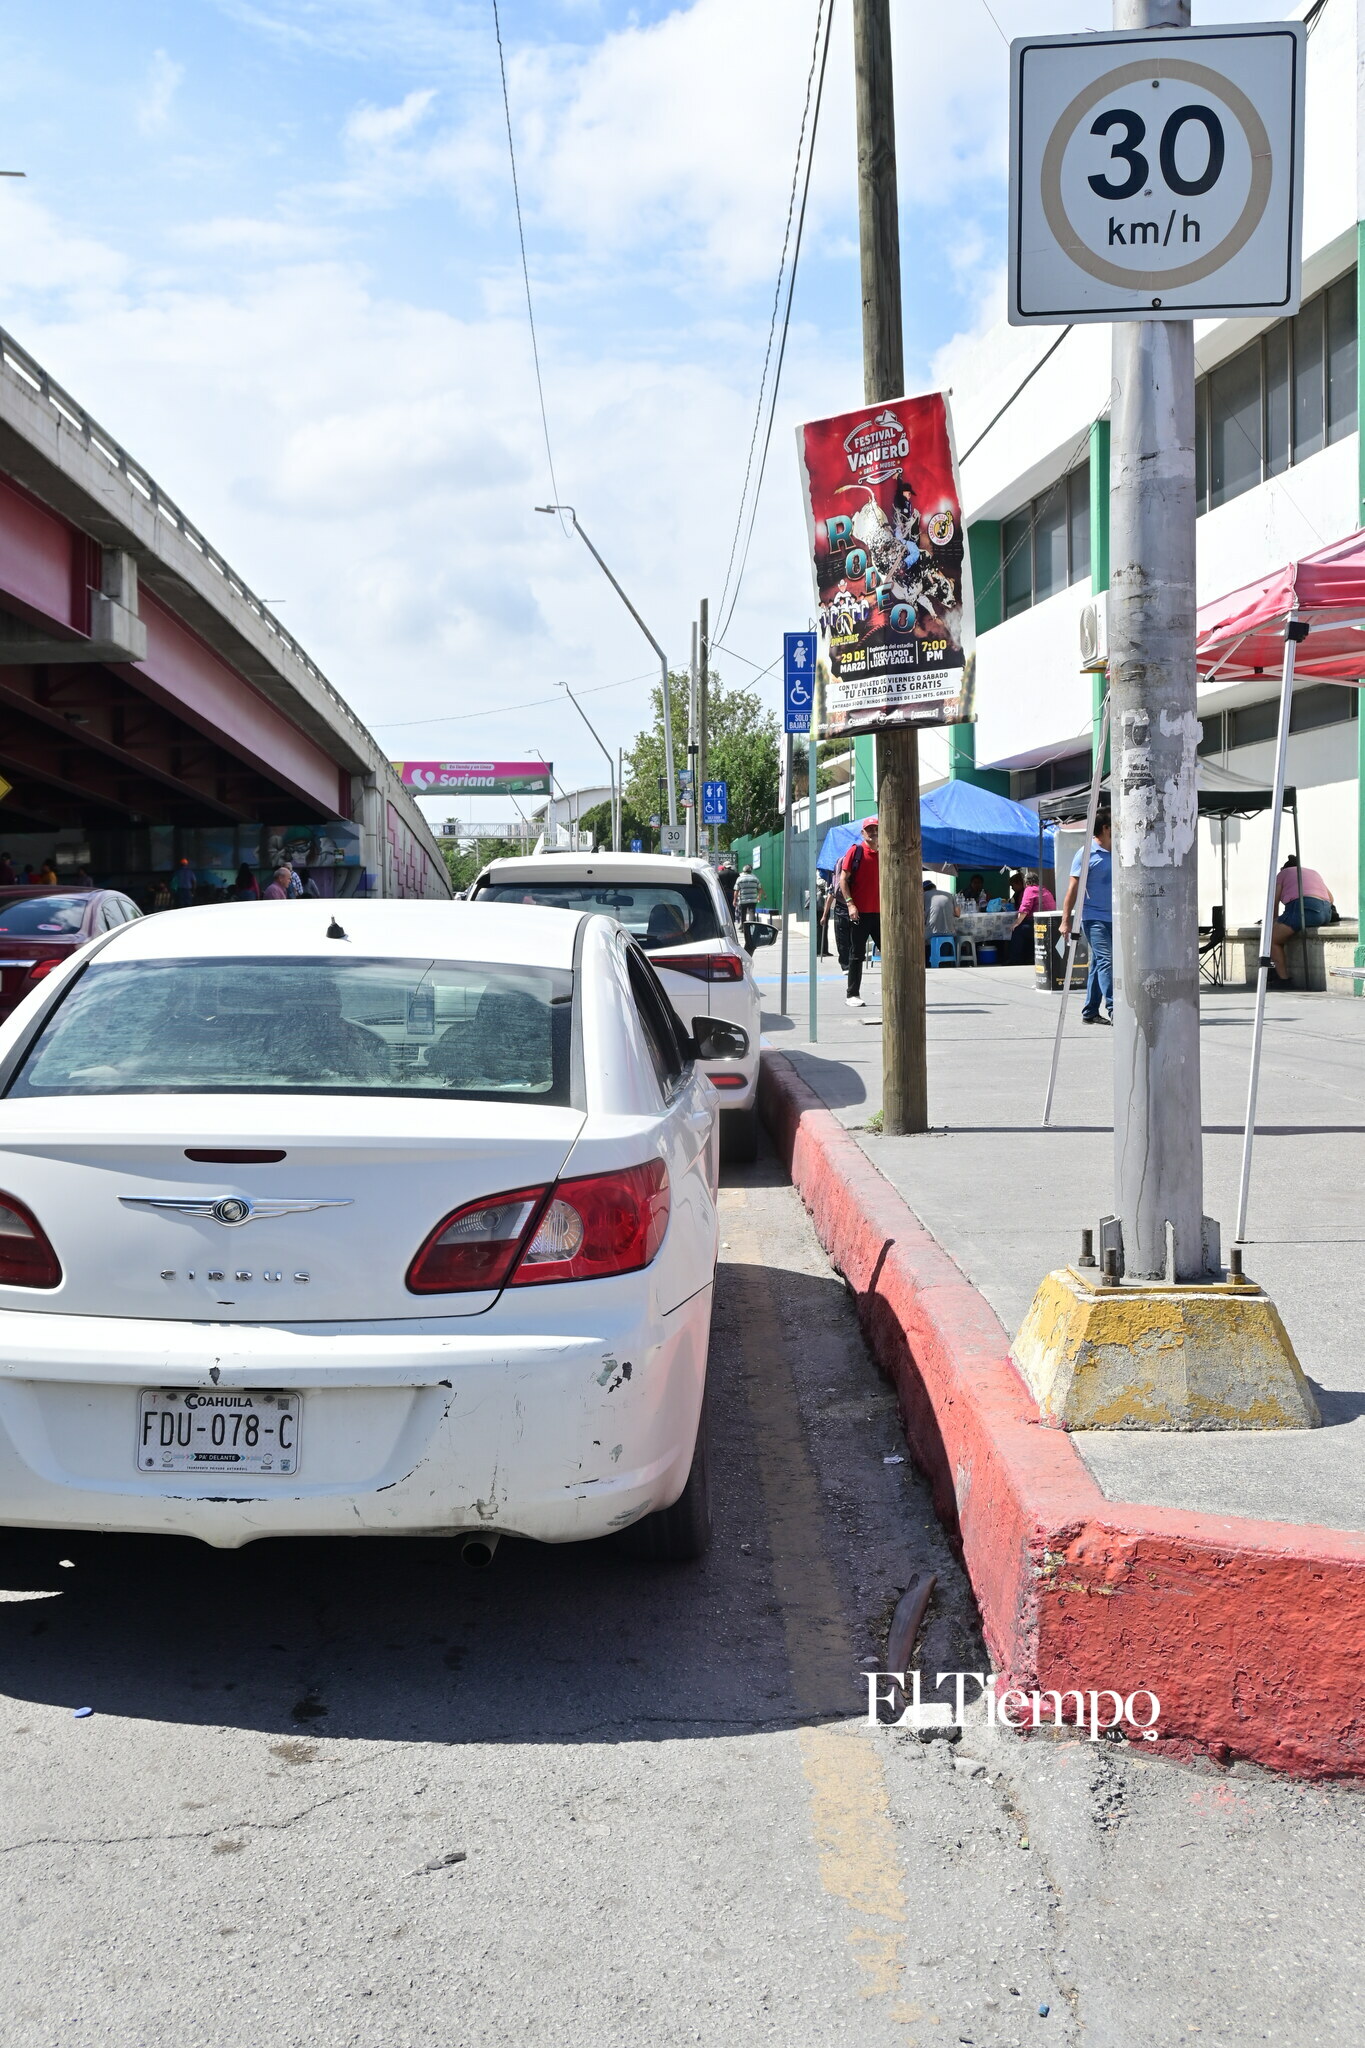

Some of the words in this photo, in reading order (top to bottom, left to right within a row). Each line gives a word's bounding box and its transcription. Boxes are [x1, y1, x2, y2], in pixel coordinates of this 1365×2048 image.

[1088, 104, 1225, 200] 30
[1108, 210, 1201, 246] km/h
[854, 428, 896, 449] FESTIVAL
[880, 460, 896, 469] MUSIC
[826, 515, 917, 633] RODEO
[921, 640, 947, 652] 7:00
[841, 653, 853, 664] 29
[854, 650, 865, 660] DE
[872, 649, 909, 660] KICKAPOO
[926, 650, 943, 662] PM
[840, 660, 866, 673] MARZO
[870, 658, 889, 668] LUCKY
[890, 656, 914, 665] EAGLE
[859, 680, 879, 688] BOLETO
[887, 675, 915, 683] VIERNES
[845, 690, 855, 699] TU
[857, 684, 894, 697] ENTRADA
[896, 684, 907, 692] ES
[909, 680, 942, 690] GRATIS
[936, 689, 955, 697] GRATIS
[795, 714, 809, 722] SOLO
[789, 721, 806, 729] BAJAR
[439, 773, 495, 787] Soriana
[667, 831, 680, 840] 30
[160, 1269, 311, 1283] CIRRUS
[184, 1392, 253, 1410] COAHUILA
[142, 1411, 293, 1449] FDU-078-C
